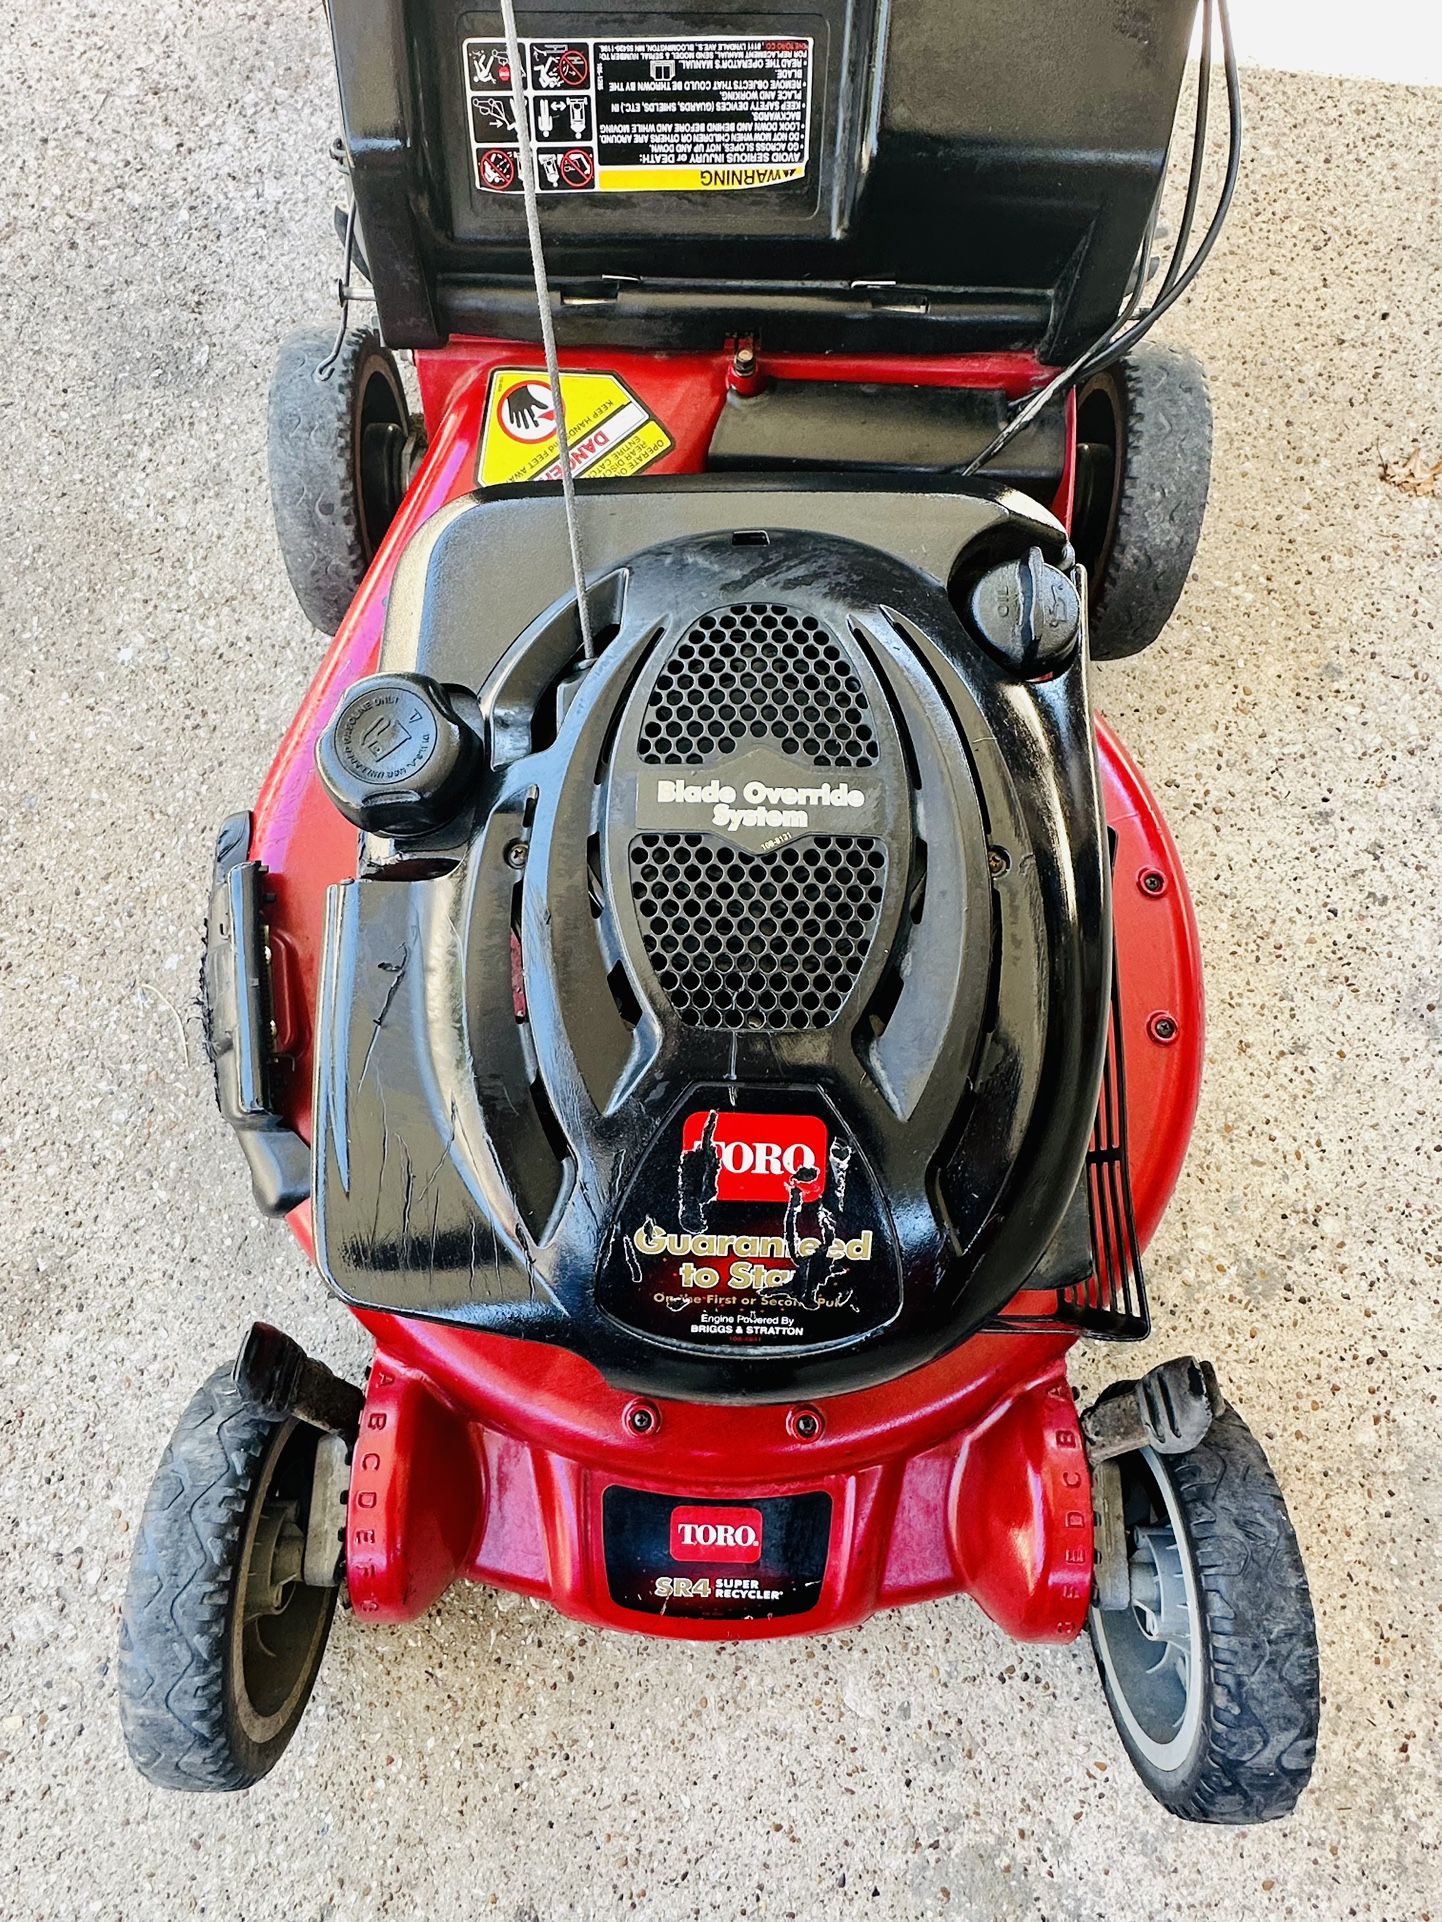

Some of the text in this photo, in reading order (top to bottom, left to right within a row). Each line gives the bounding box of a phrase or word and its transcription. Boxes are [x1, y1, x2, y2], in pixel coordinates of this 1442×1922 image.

[696, 51, 714, 59] SEND
[679, 59, 802, 69] READ THE OPERATOR'S MANUAL.
[775, 69, 802, 78] BLADE.
[609, 80, 802, 91] REMOVE OBJECTS THAT COULD BE THROWN BY THE
[720, 90, 802, 100] PLACE AND WORKING.
[611, 101, 801, 113] KEEP SAFETY DEVICES (GUARDS, SHIELDS, ETC.) IN
[752, 111, 801, 121] BACKWARDS.
[600, 122, 800, 133] LOOK DOWN AND BEHIND BEFORE AND WHILE MOVING
[599, 132, 799, 143] DO NOT MOW WHEN CHILDREN OR OTHERS ARE AROUND.
[649, 144, 674, 152] DOWN.
[676, 144, 692, 152] AND
[693, 144, 704, 152] UP
[705, 143, 721, 152] NOT
[756, 142, 786, 151] ACROSS
[787, 142, 799, 151] GO
[639, 152, 800, 163] AVOID SERIOUS INJURY or DEATH:
[701, 170, 781, 186] WARNING
[592, 400, 613, 419] KEEP
[613, 436, 641, 459] ENTIRE
[625, 441, 646, 460] REAR
[528, 449, 549, 469] FEET
[628, 439, 664, 469] OPERATE
[997, 586, 1009, 617] OIL
[658, 780, 865, 807] Blade Override
[712, 804, 808, 831] System
[680, 1263, 719, 1288] to
[707, 1294, 737, 1304] First
[741, 1297, 757, 1305] or
[701, 1313, 794, 1326] Engine Powered By
[691, 1324, 804, 1336] BRIGGS & STRATTON
[368, 1412, 387, 1431] B
[1056, 1430, 1077, 1449] B
[362, 1453, 380, 1471] C
[1063, 1471, 1081, 1489] C
[356, 1491, 377, 1509] D
[1065, 1511, 1084, 1529] D
[356, 1529, 375, 1545] E
[1066, 1548, 1085, 1564] E
[654, 1577, 711, 1597] SR4
[715, 1579, 759, 1589] SUPER
[715, 1589, 780, 1599] RECYCLER
